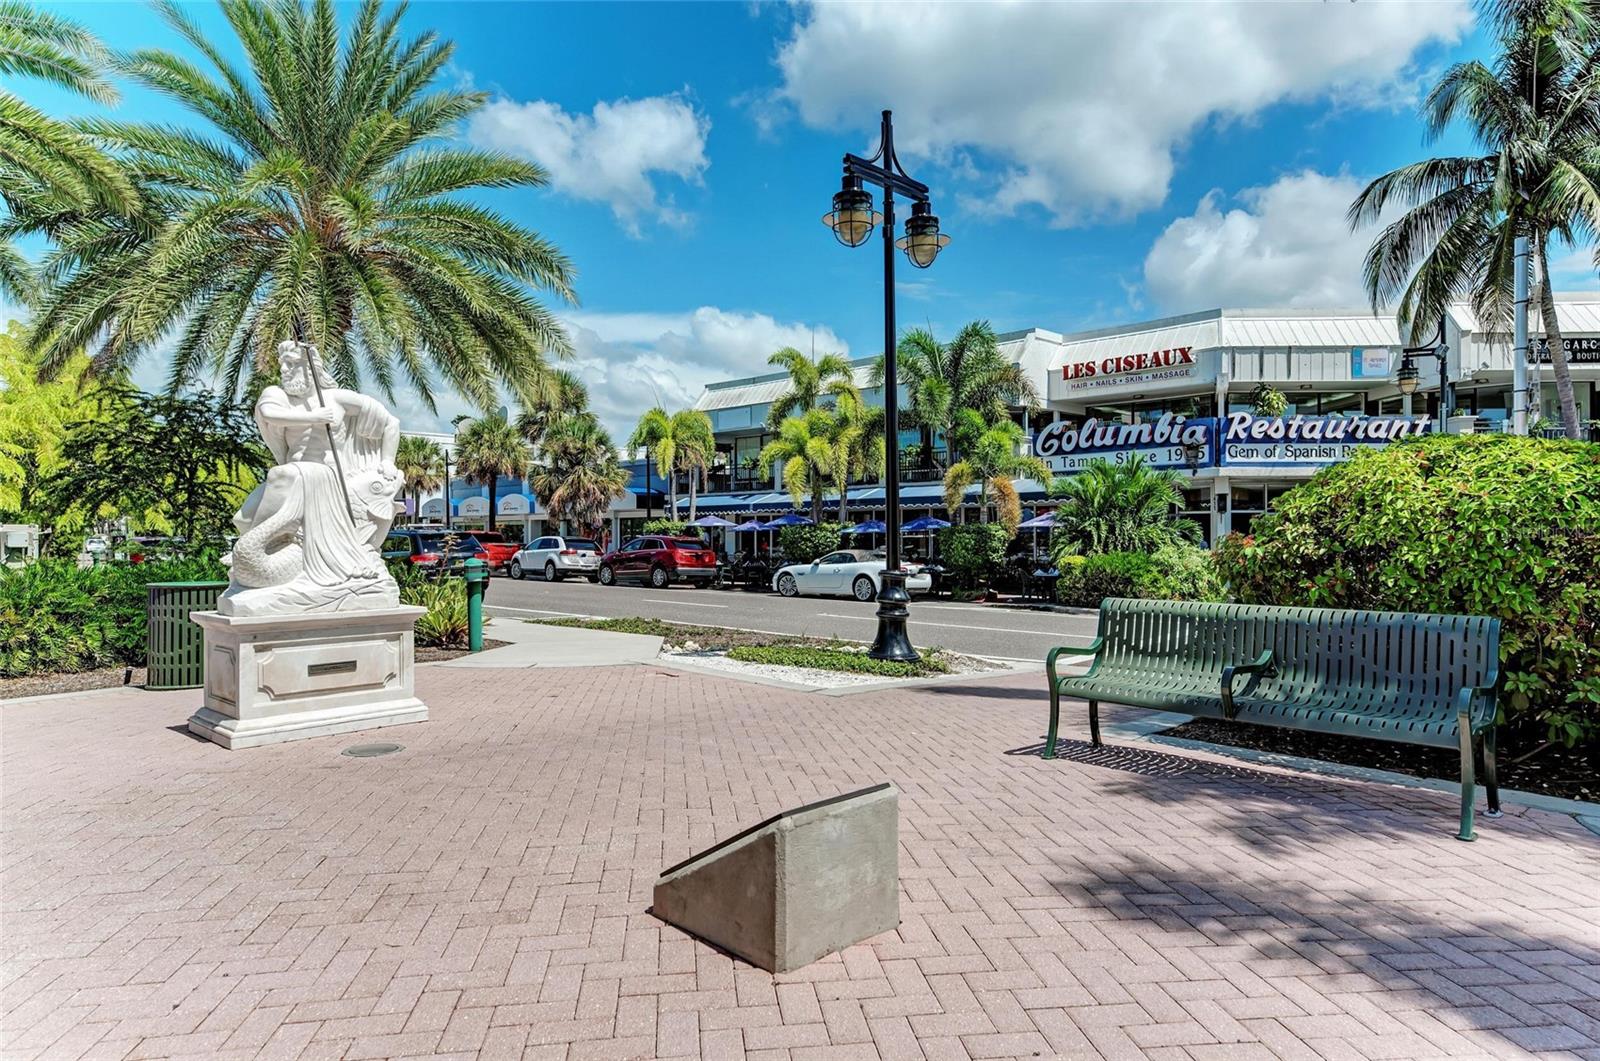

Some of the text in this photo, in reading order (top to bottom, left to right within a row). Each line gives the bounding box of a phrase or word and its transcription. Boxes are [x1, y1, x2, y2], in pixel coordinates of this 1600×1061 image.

[1062, 346, 1193, 381] LES CISEAUX
[1576, 352, 1600, 360] BOUTI
[1071, 369, 1190, 390] HAIR NAILS SKIN MASSAGE
[1035, 411, 1430, 456] Columbia Restaurant
[1061, 456, 1106, 469] Tampa
[1115, 451, 1157, 464] Sice
[1166, 447, 1205, 462] 195
[1228, 444, 1259, 458] Gem
[1264, 444, 1278, 458] of
[1284, 444, 1337, 461] Spanish
